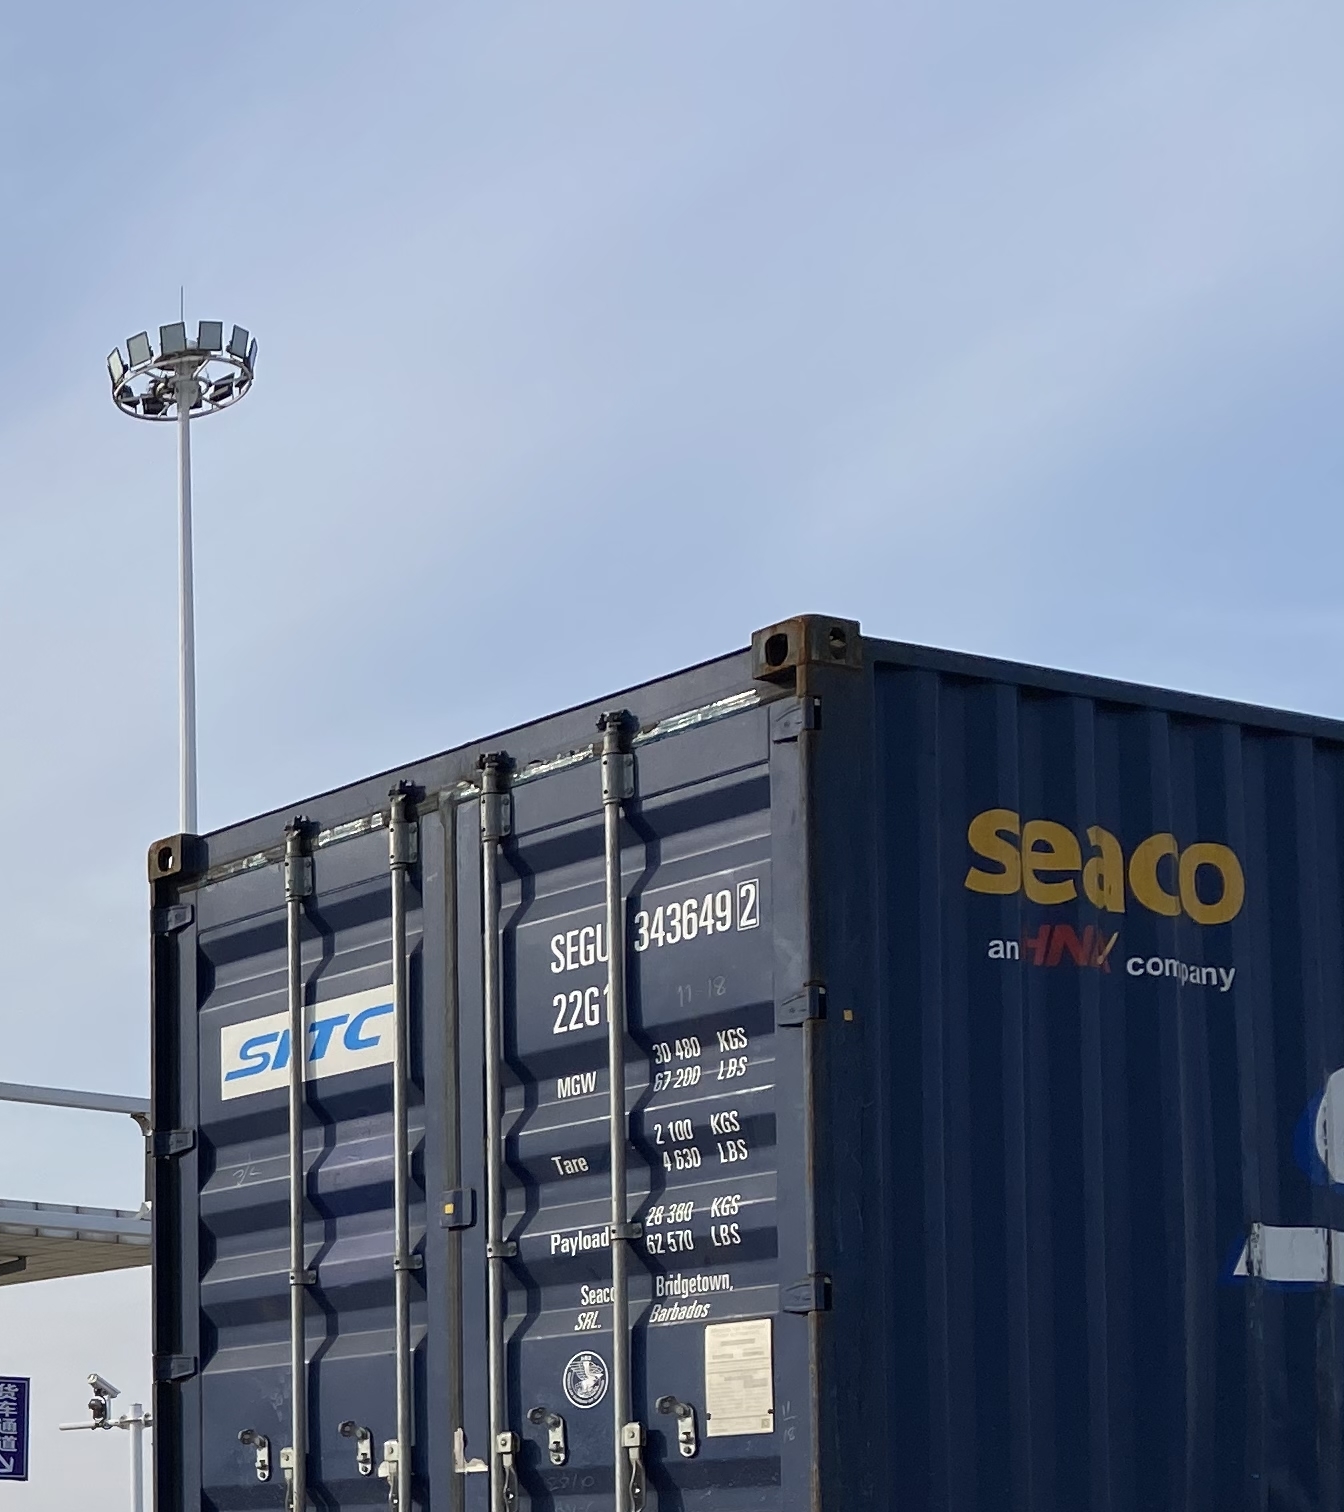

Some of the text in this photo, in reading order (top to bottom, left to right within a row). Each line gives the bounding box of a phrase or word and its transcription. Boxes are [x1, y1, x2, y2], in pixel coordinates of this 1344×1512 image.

[964, 808, 1245, 924] seaco
[550, 883, 757, 974] SEGU 343649 2
[988, 938, 1019, 960] an
[1126, 956, 1236, 992] company
[224, 1003, 394, 1082] SITC
[652, 1027, 748, 1065] 30 480 KGS
[557, 1071, 597, 1099] MGW
[653, 1056, 748, 1092] 67 200 LBS
[667, 1118, 694, 1142] 100
[710, 1110, 741, 1135] KGS
[551, 1156, 589, 1176] Tare
[673, 1147, 702, 1170] 630
[717, 1139, 748, 1164] LBS
[646, 1194, 741, 1227] 28 380 KGS
[550, 1226, 610, 1256] Payload
[646, 1223, 741, 1255] 62 570 LBS
[656, 1273, 734, 1299] Bridgetown,
[574, 1310, 602, 1331] SRL.
[649, 1300, 711, 1323] Barbados
